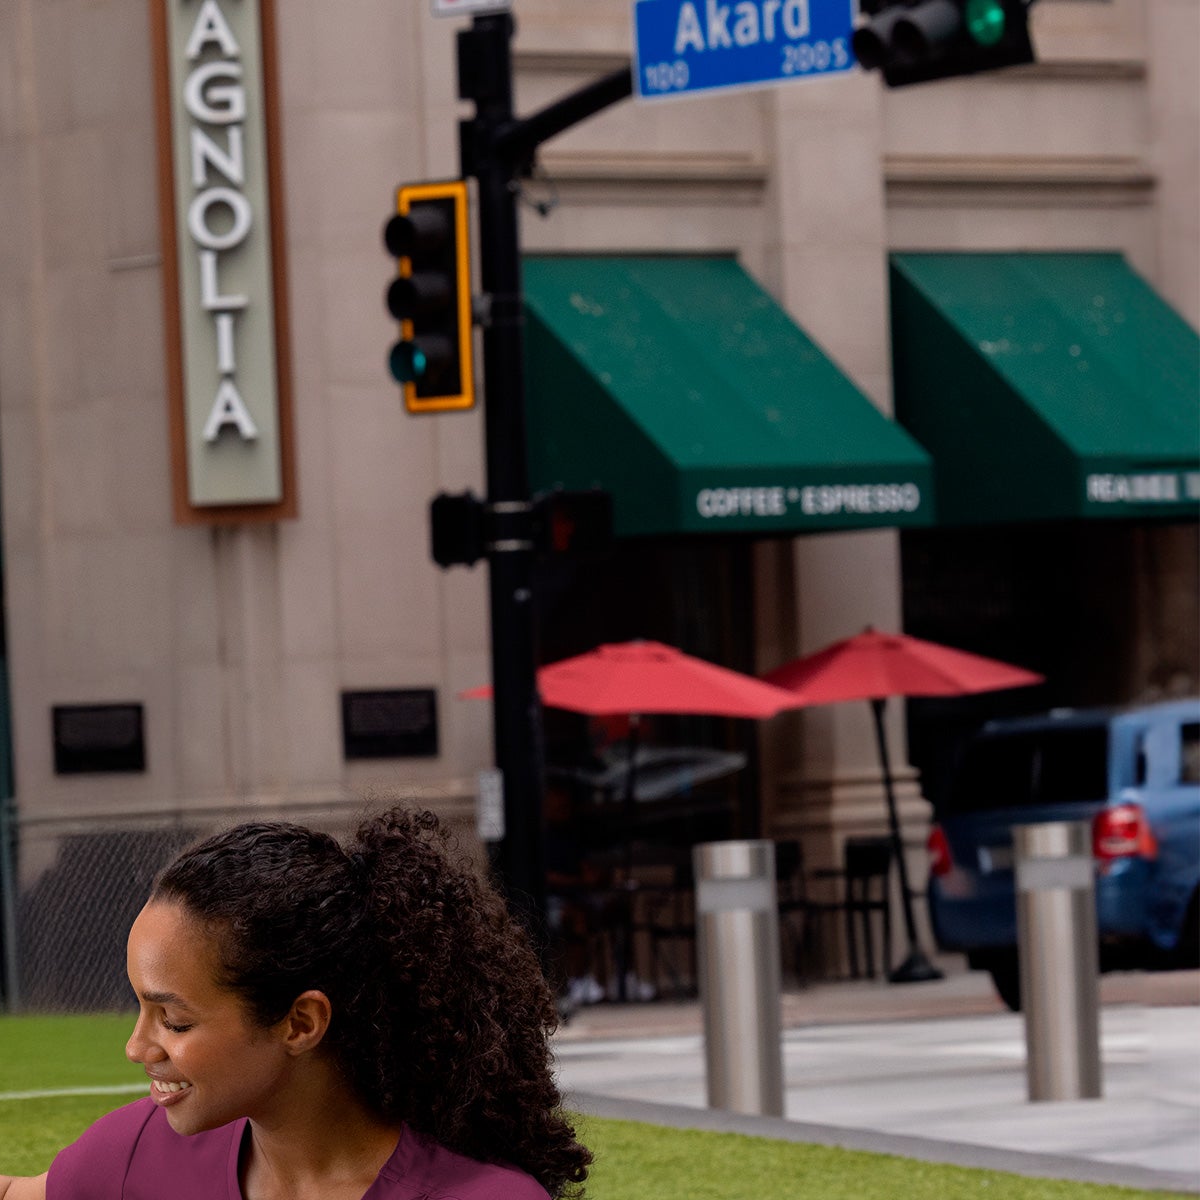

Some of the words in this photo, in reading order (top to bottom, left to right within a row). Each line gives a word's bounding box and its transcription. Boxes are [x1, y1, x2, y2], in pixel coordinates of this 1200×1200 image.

[675, 0, 811, 54] Akard
[696, 486, 788, 518] COFFEE
[801, 482, 920, 514] ESPRESSO
